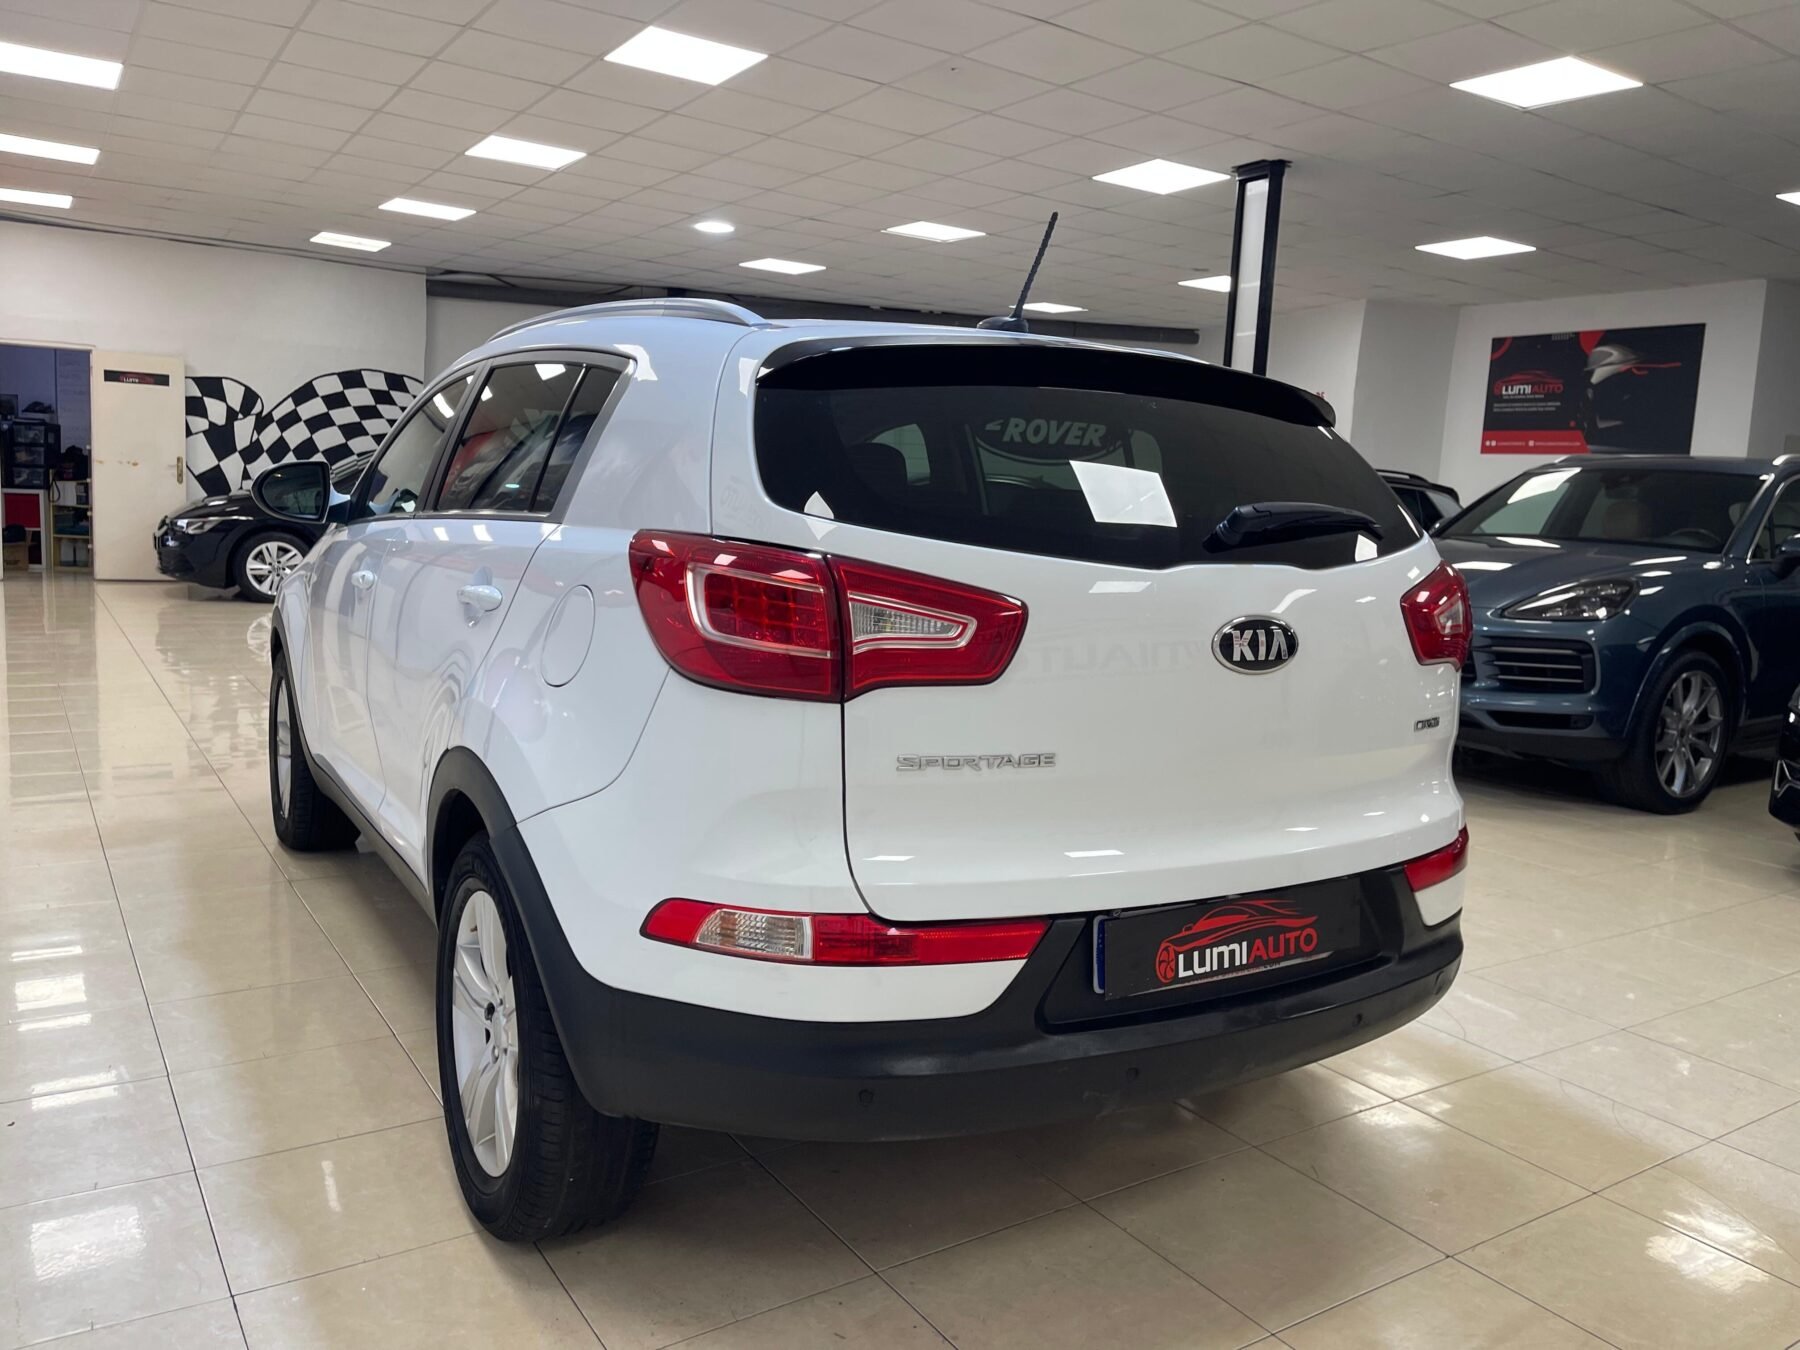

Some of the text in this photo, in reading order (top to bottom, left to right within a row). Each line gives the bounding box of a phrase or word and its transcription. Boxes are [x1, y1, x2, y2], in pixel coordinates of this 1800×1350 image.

[1002, 417, 1107, 447] ROVER
[1231, 629, 1289, 661] KIA
[896, 753, 1057, 772] SPORTAGE
